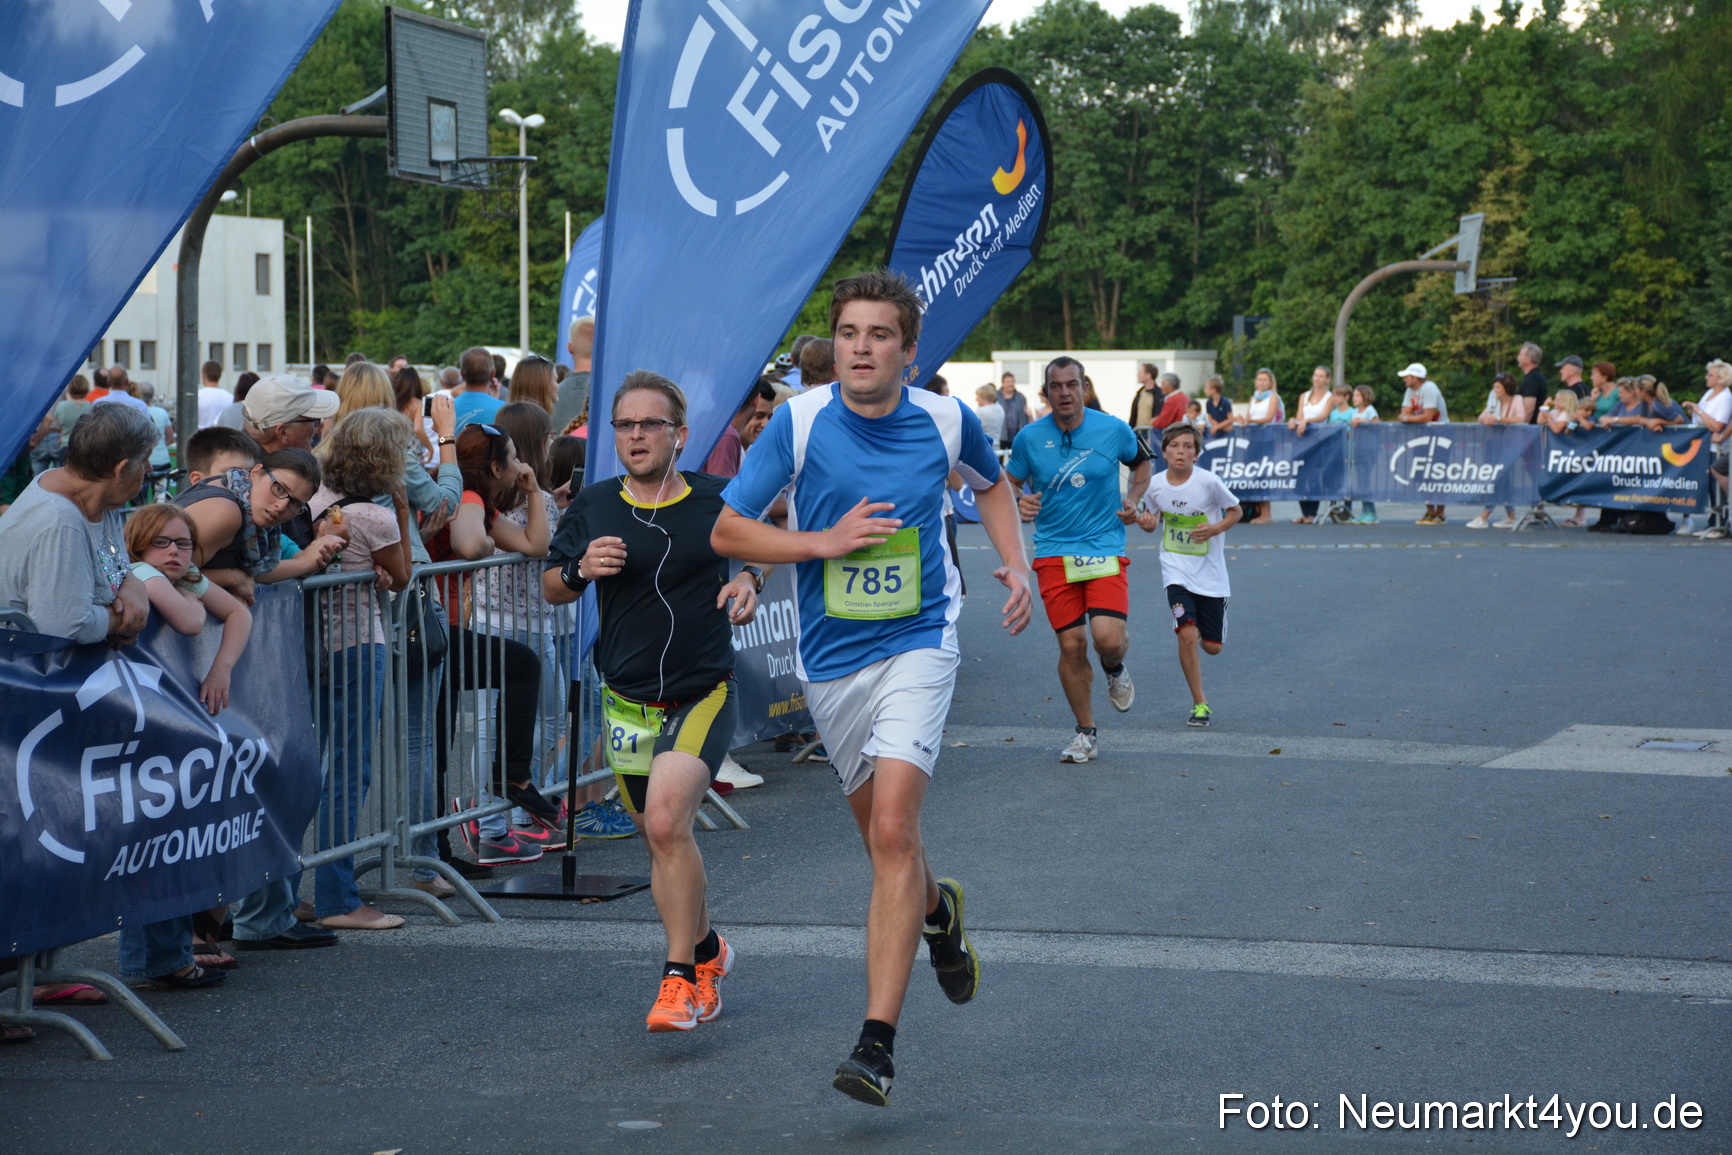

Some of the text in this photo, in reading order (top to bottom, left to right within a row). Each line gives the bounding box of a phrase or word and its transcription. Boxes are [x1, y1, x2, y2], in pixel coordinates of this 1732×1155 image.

[953, 253, 985, 298] Druck
[1005, 183, 1042, 240] Medien
[1047, 473, 1060, 490] Team
[1059, 456, 1080, 473] Schick
[1210, 456, 1305, 478] Fischer
[1409, 457, 1504, 481] Fischer
[1547, 449, 1662, 475] Frischmann
[1418, 482, 1495, 494] AUTOMOBILE
[1612, 474, 1698, 490] Druck und Medien
[842, 565, 902, 595] 785
[844, 600, 900, 608] Christian Spangler
[766, 648, 796, 678] Druck
[80, 723, 270, 832] Fischer
[104, 807, 265, 881] AUTOMOBILE
